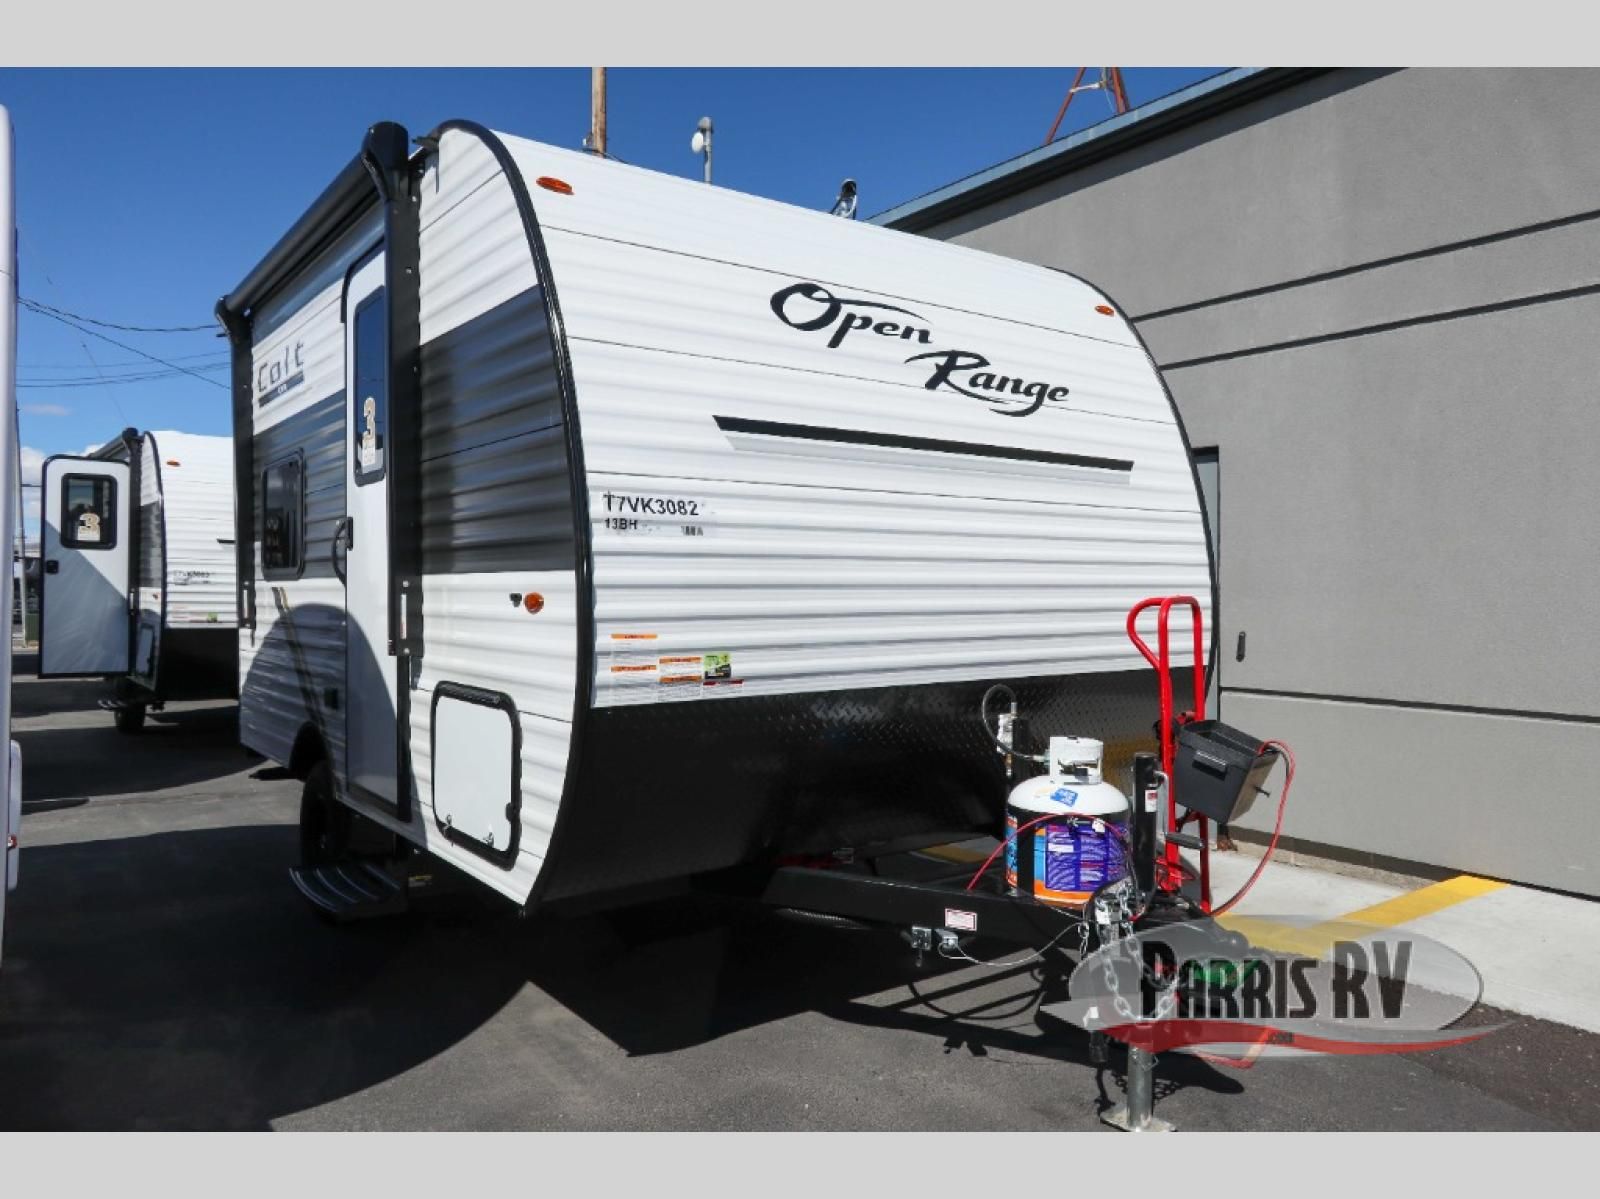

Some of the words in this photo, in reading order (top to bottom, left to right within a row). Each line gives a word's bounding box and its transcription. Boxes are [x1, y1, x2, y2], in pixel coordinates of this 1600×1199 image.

[769, 282, 933, 349] Open
[257, 340, 304, 393] Colt
[904, 350, 1070, 417] Range
[602, 489, 700, 516] T7VK3082
[604, 517, 638, 530] 13BH
